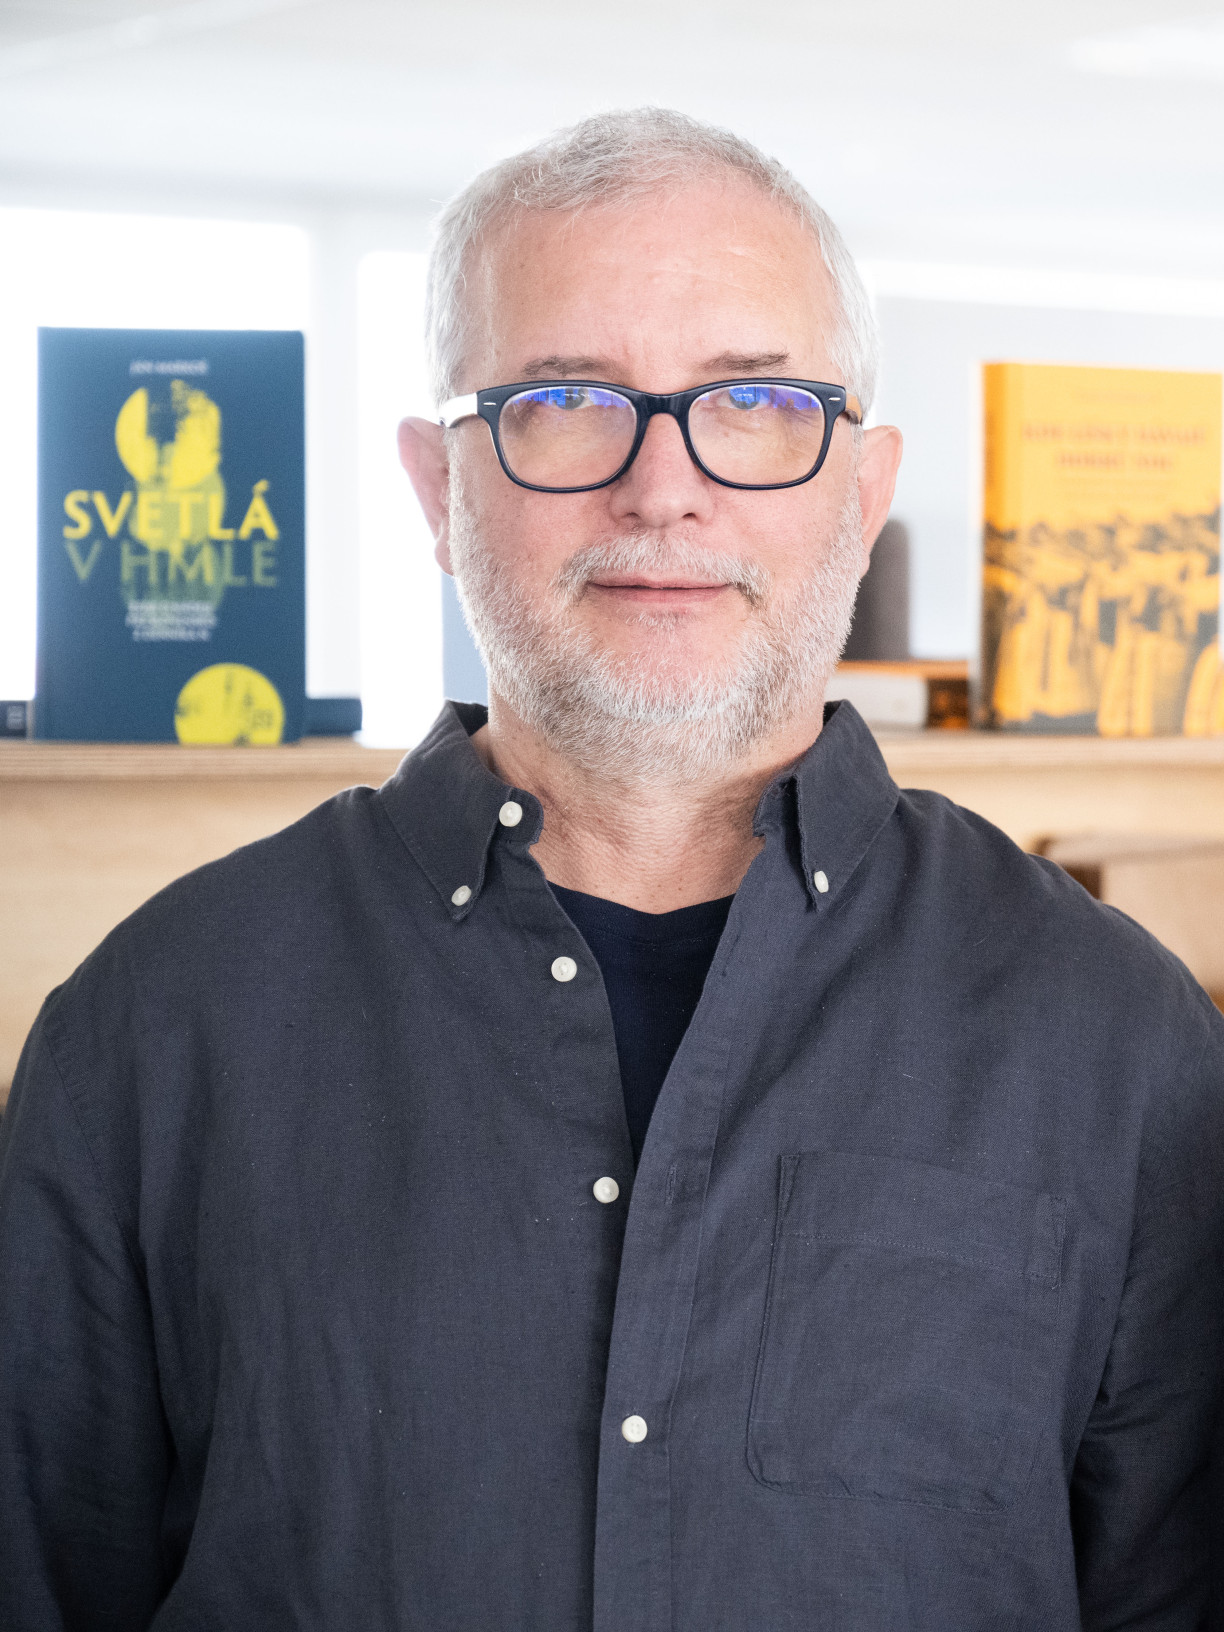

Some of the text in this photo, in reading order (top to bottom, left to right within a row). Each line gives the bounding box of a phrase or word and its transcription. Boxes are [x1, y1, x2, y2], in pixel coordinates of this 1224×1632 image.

[63, 480, 279, 540] SVETLÁ
[64, 540, 277, 586] V HMLE
